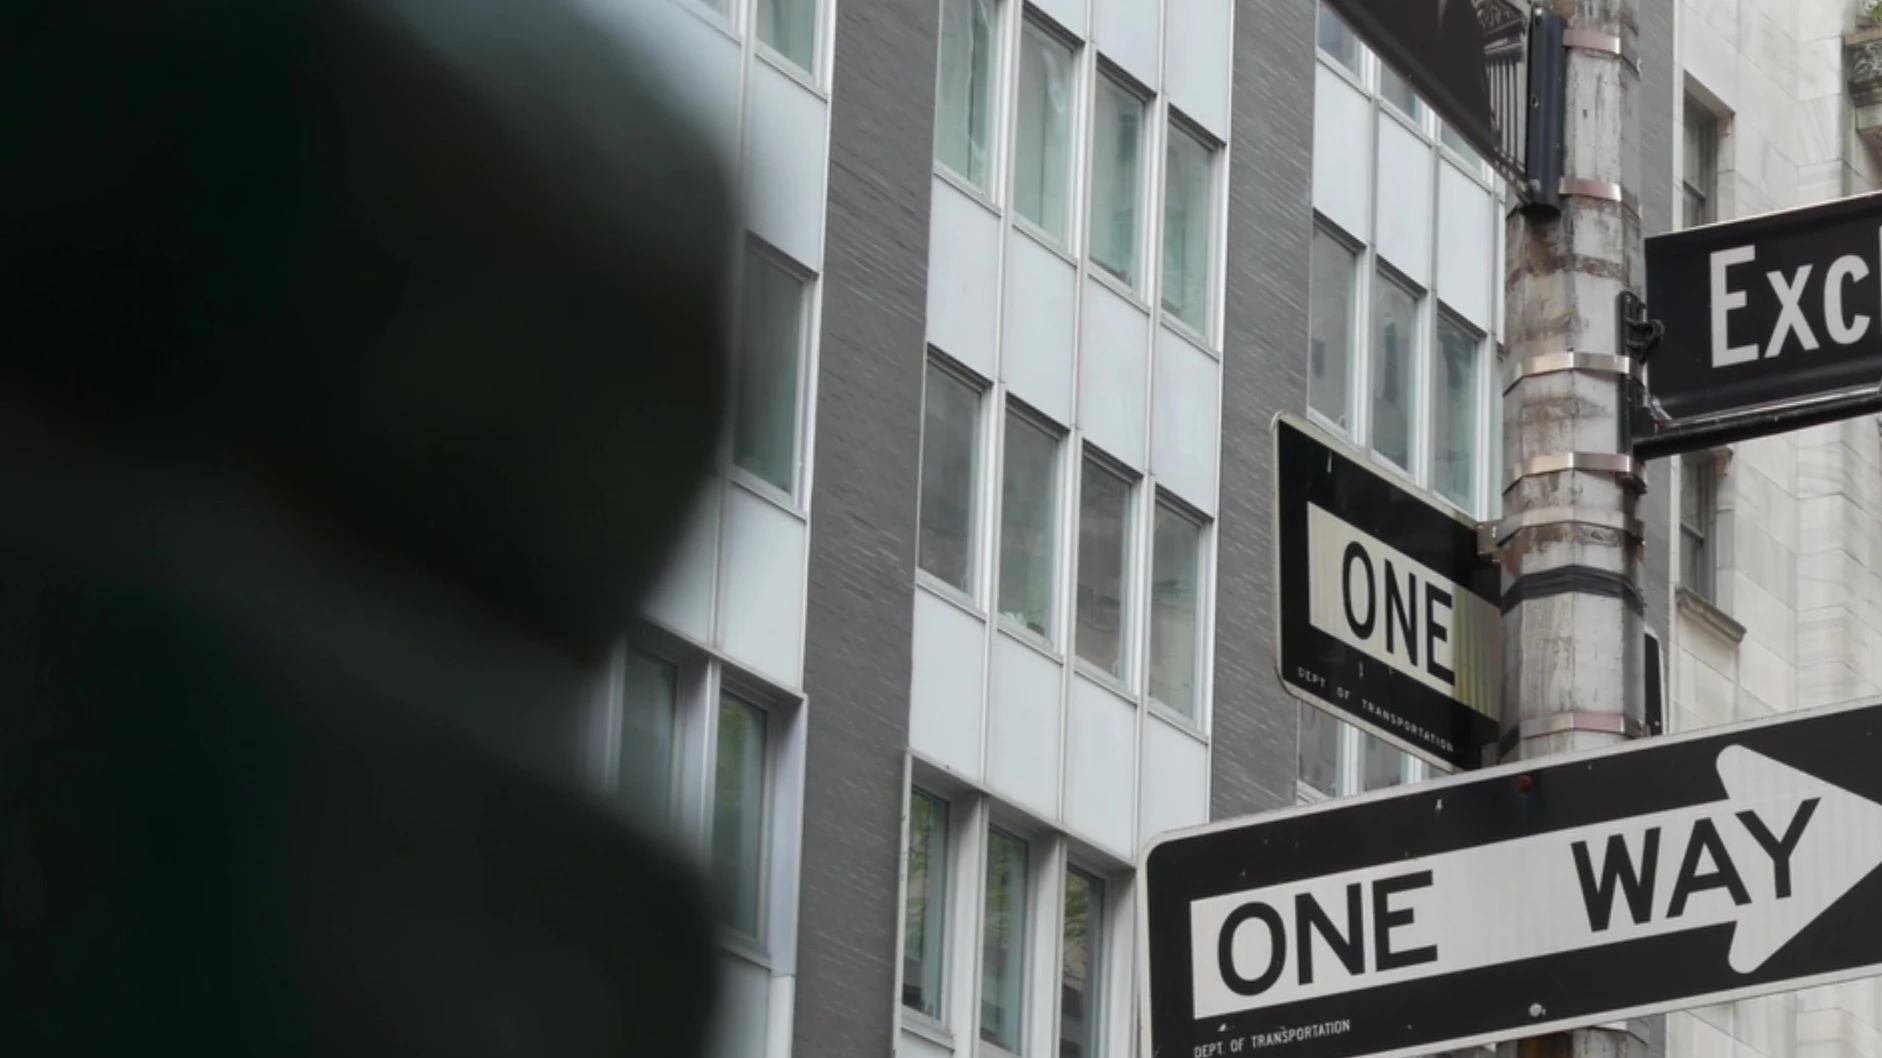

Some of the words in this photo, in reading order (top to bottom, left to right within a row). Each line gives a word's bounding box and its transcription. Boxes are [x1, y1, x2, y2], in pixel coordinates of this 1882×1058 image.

[1341, 540, 1456, 686] ONE
[1336, 685, 1351, 701] OF
[1361, 698, 1454, 753] TRANSPORTATION
[1216, 869, 1439, 997] ONE
[1570, 796, 1823, 933] WAY
[1229, 1036, 1245, 1053] OF
[1251, 1018, 1351, 1049] TRANSPORTATION
